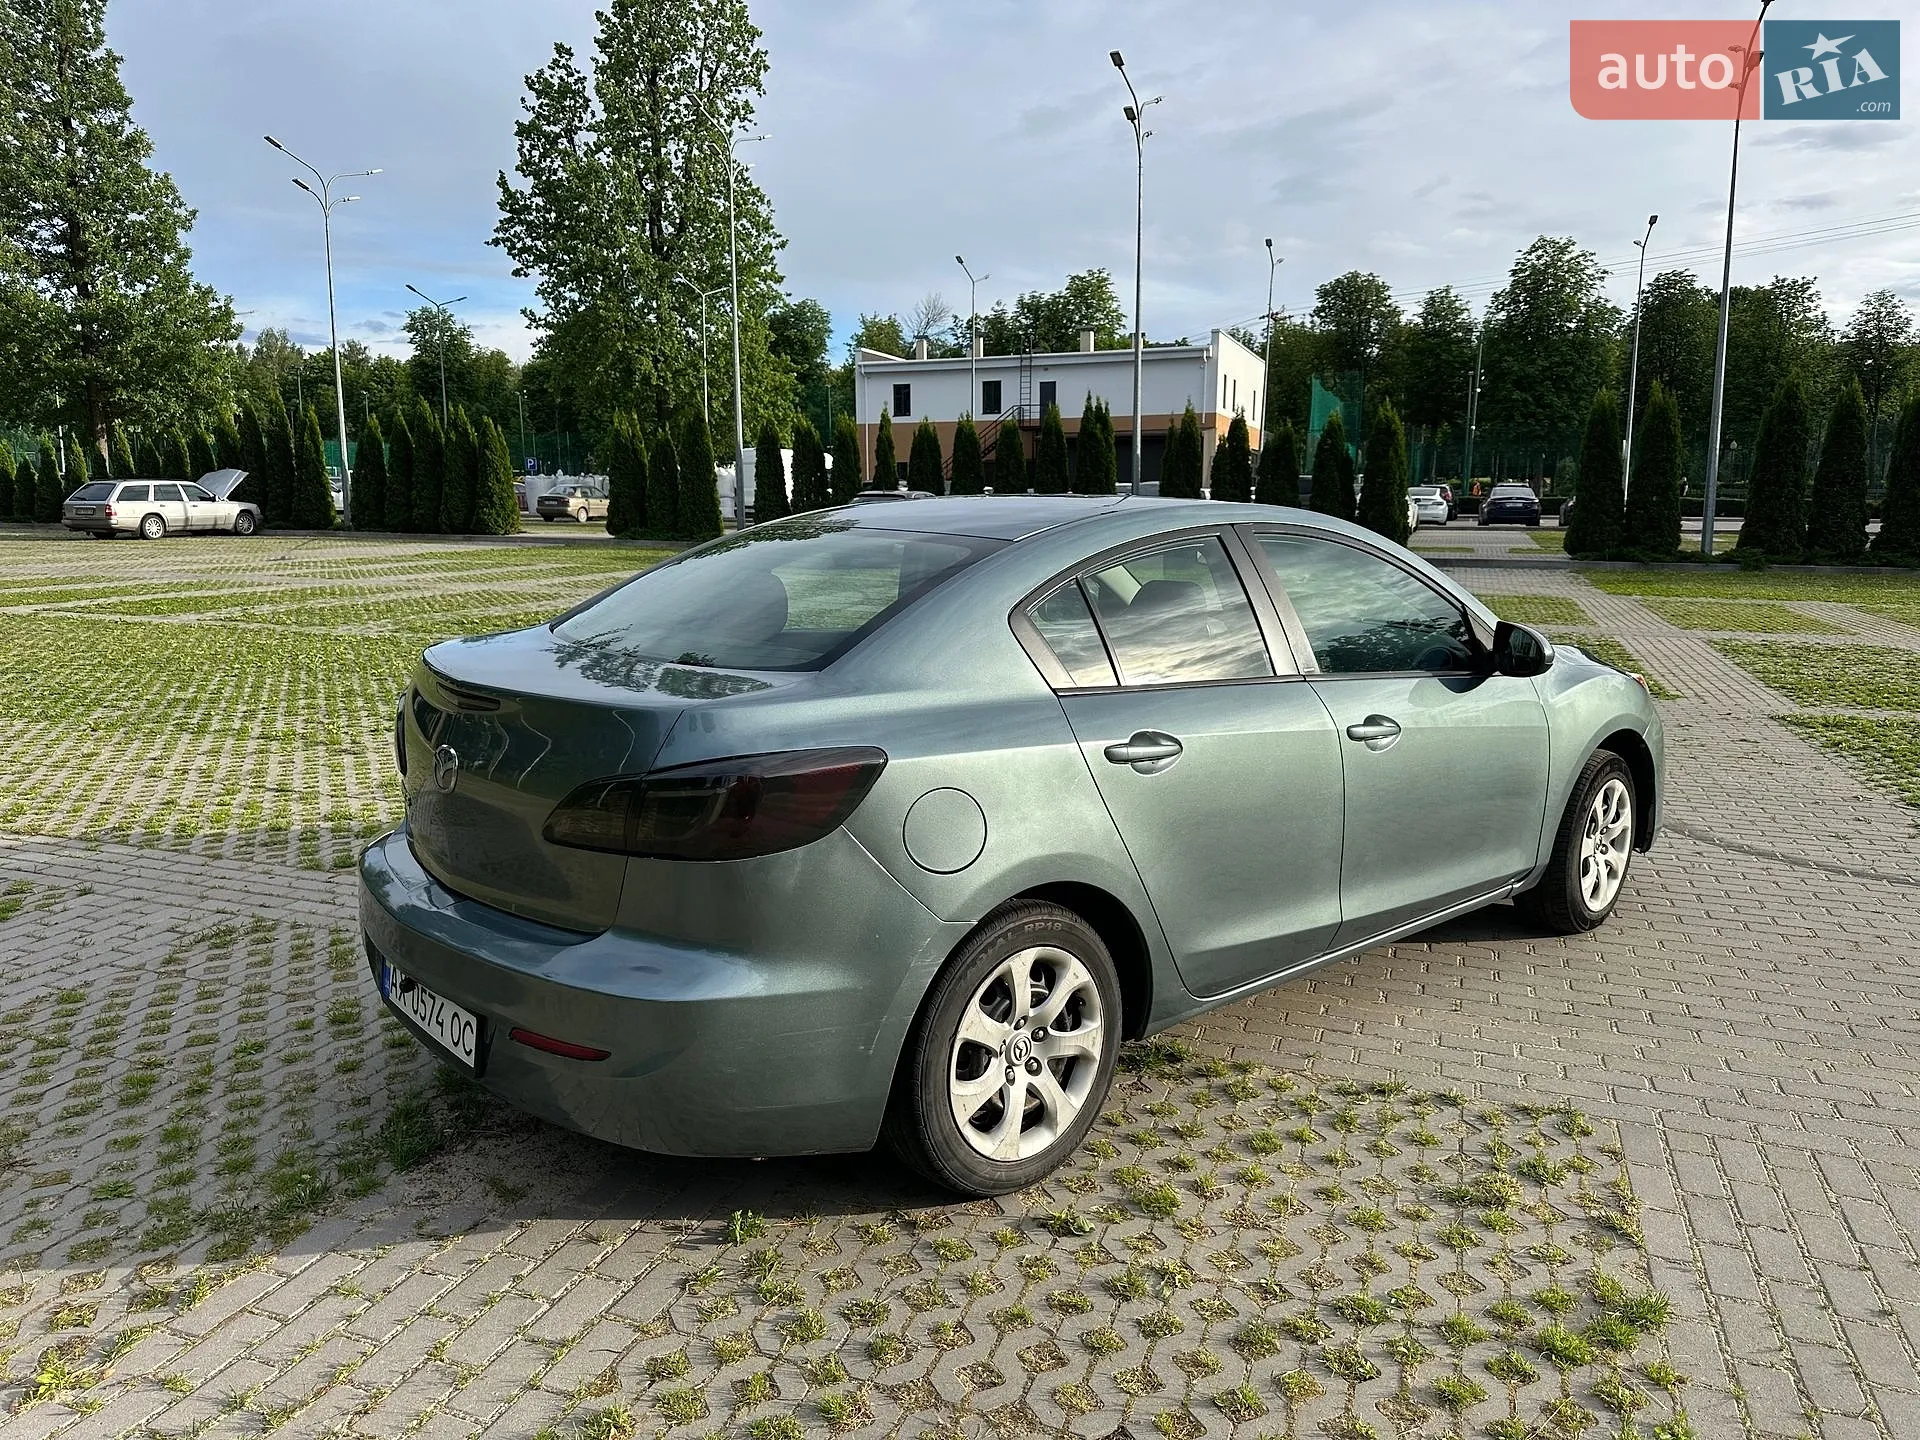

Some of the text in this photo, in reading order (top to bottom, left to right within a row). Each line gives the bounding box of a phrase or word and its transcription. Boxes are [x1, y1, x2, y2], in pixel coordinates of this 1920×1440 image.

[527, 458, 535, 469] P
[411, 983, 445, 1037] 0574
[451, 1011, 474, 1057] OC
